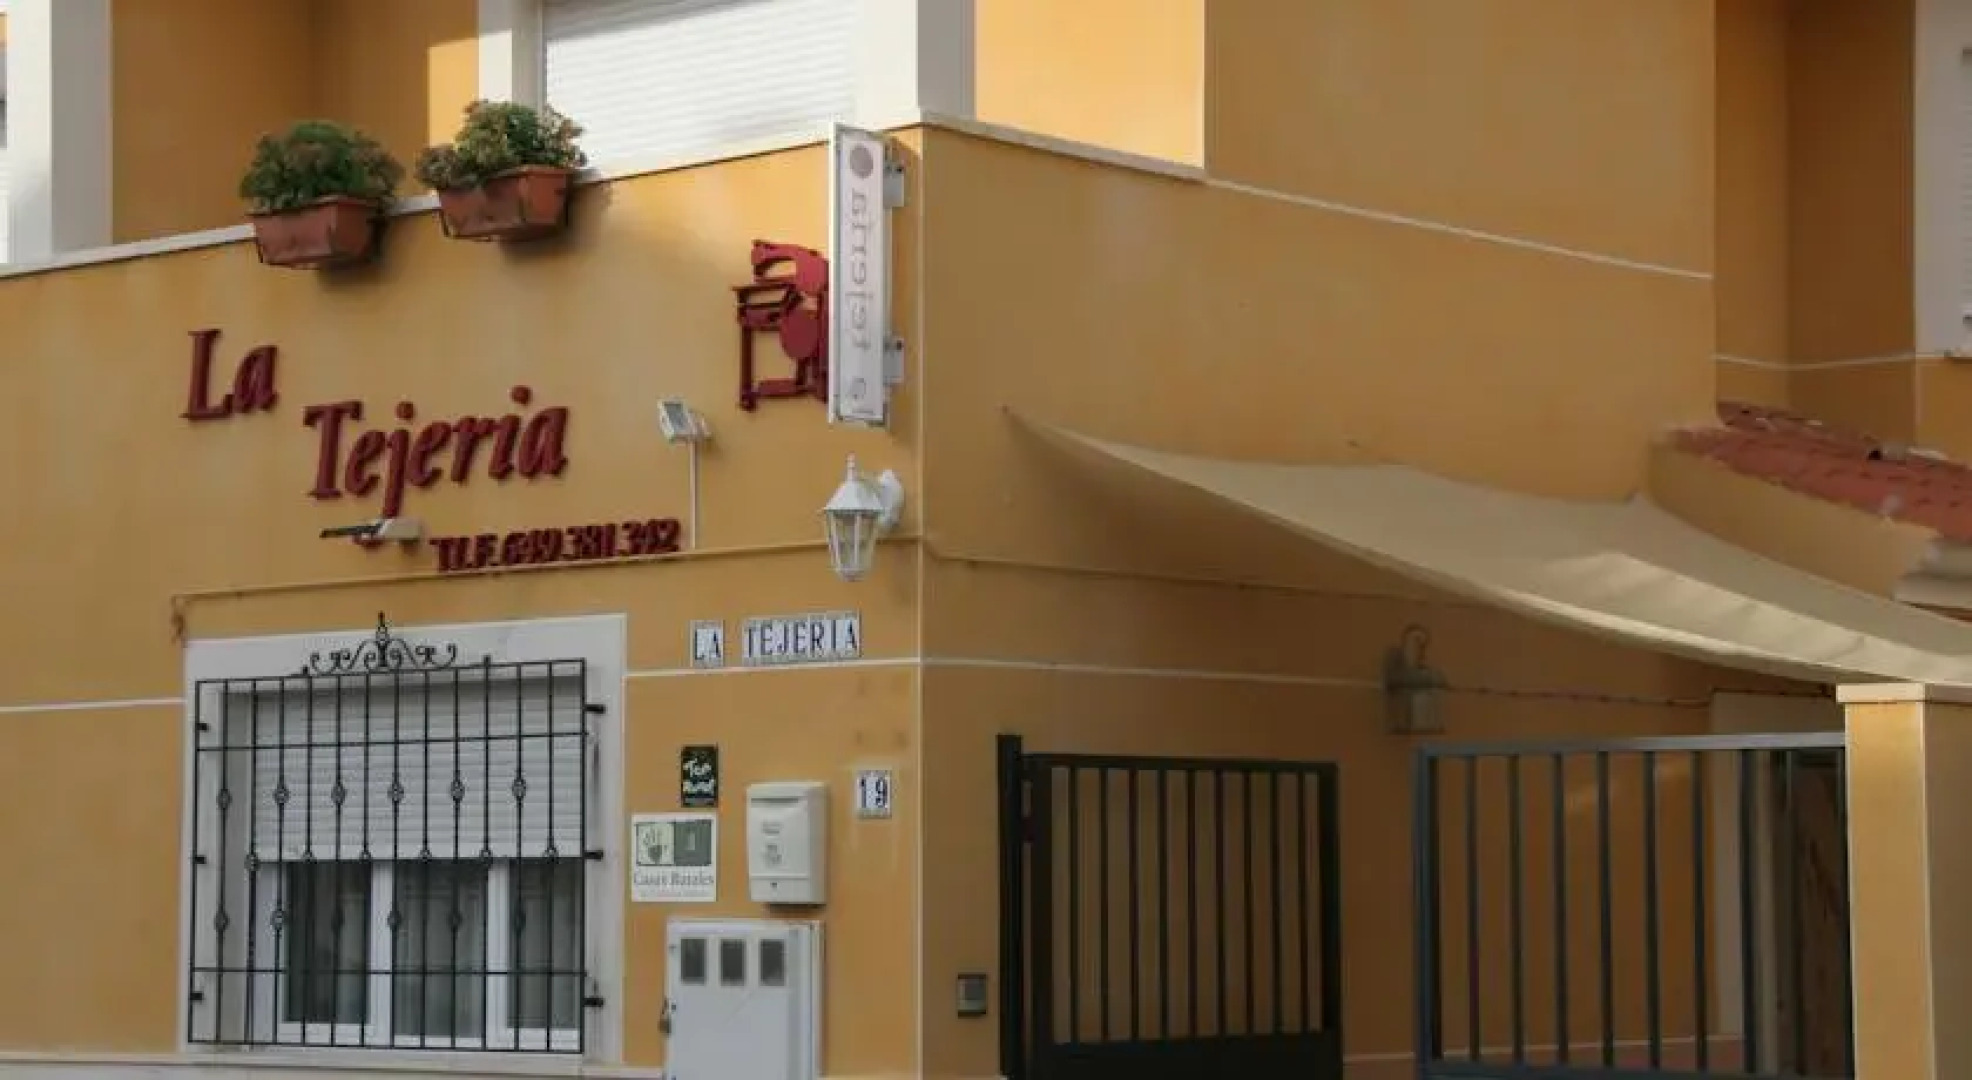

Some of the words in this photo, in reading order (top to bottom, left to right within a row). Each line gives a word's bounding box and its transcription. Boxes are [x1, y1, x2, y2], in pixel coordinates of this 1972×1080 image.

[180, 328, 279, 420] La
[303, 385, 568, 547] Tejeria
[694, 628, 722, 660] LA
[745, 619, 858, 657] TEJERIA
[859, 775, 888, 809] 19
